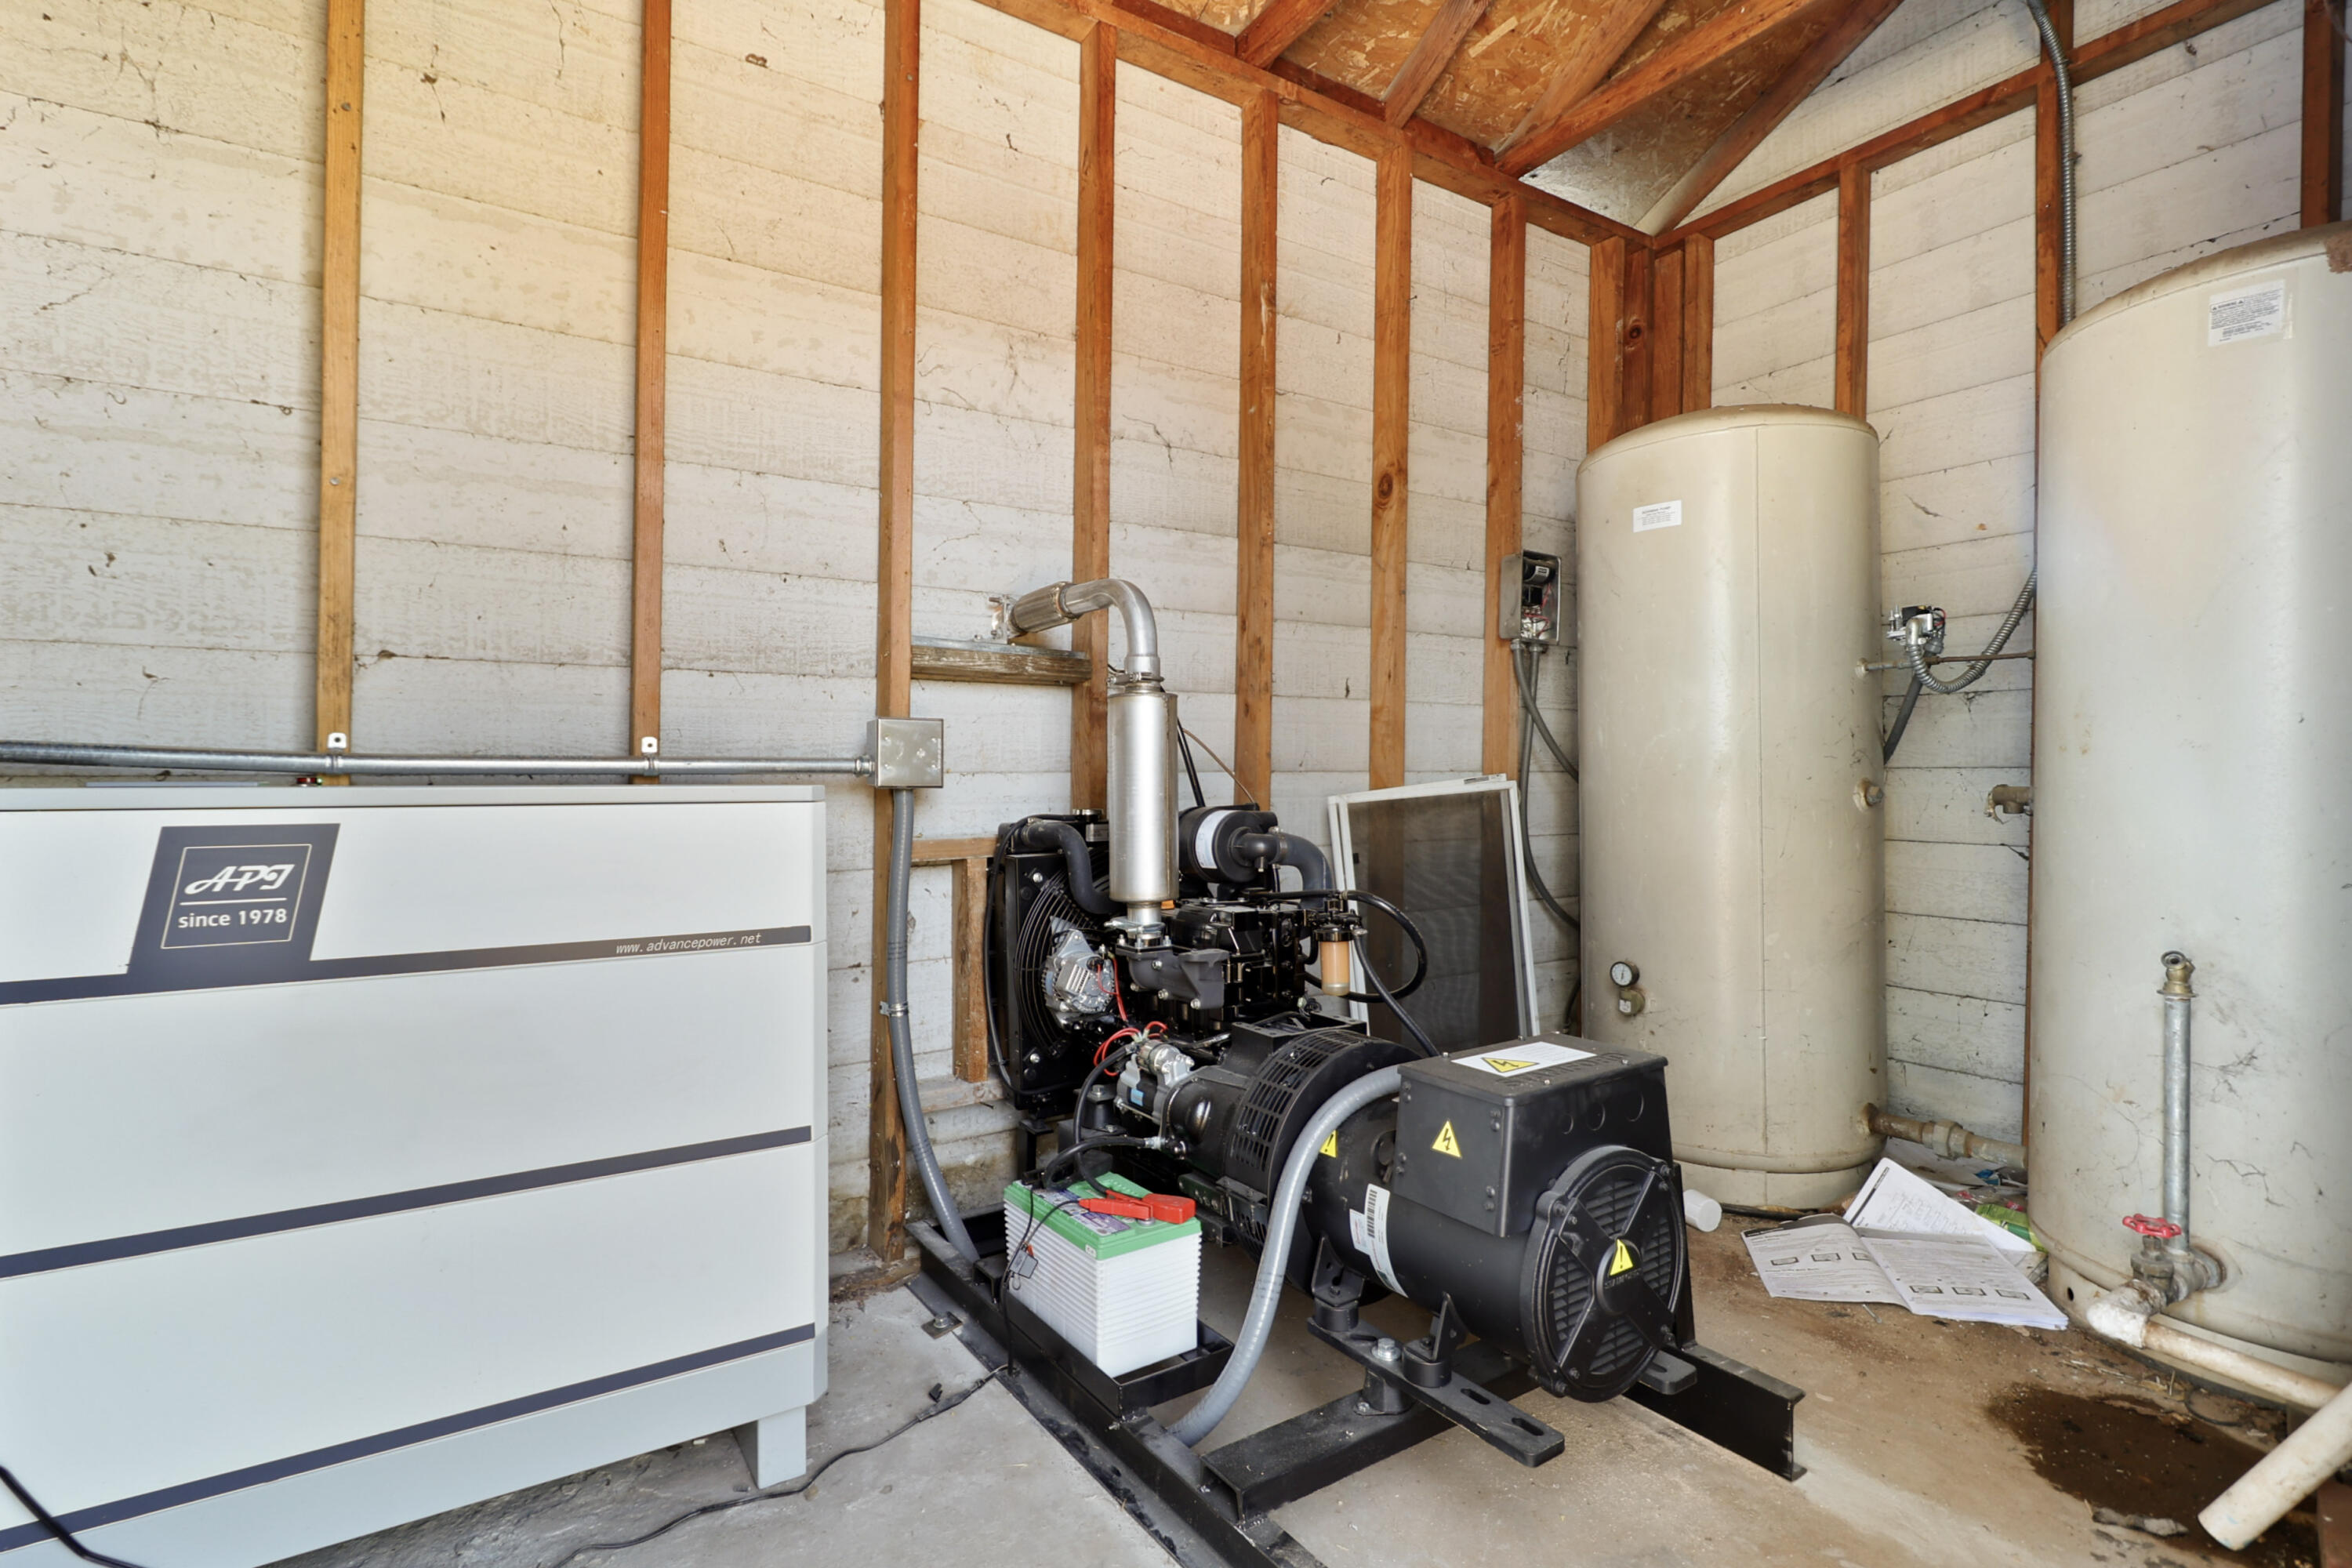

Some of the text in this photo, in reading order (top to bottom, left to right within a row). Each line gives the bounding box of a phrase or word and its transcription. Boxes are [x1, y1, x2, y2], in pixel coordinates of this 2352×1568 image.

[178, 908, 288, 928] since 1978
[615, 932, 762, 954] www.advancepower.net
